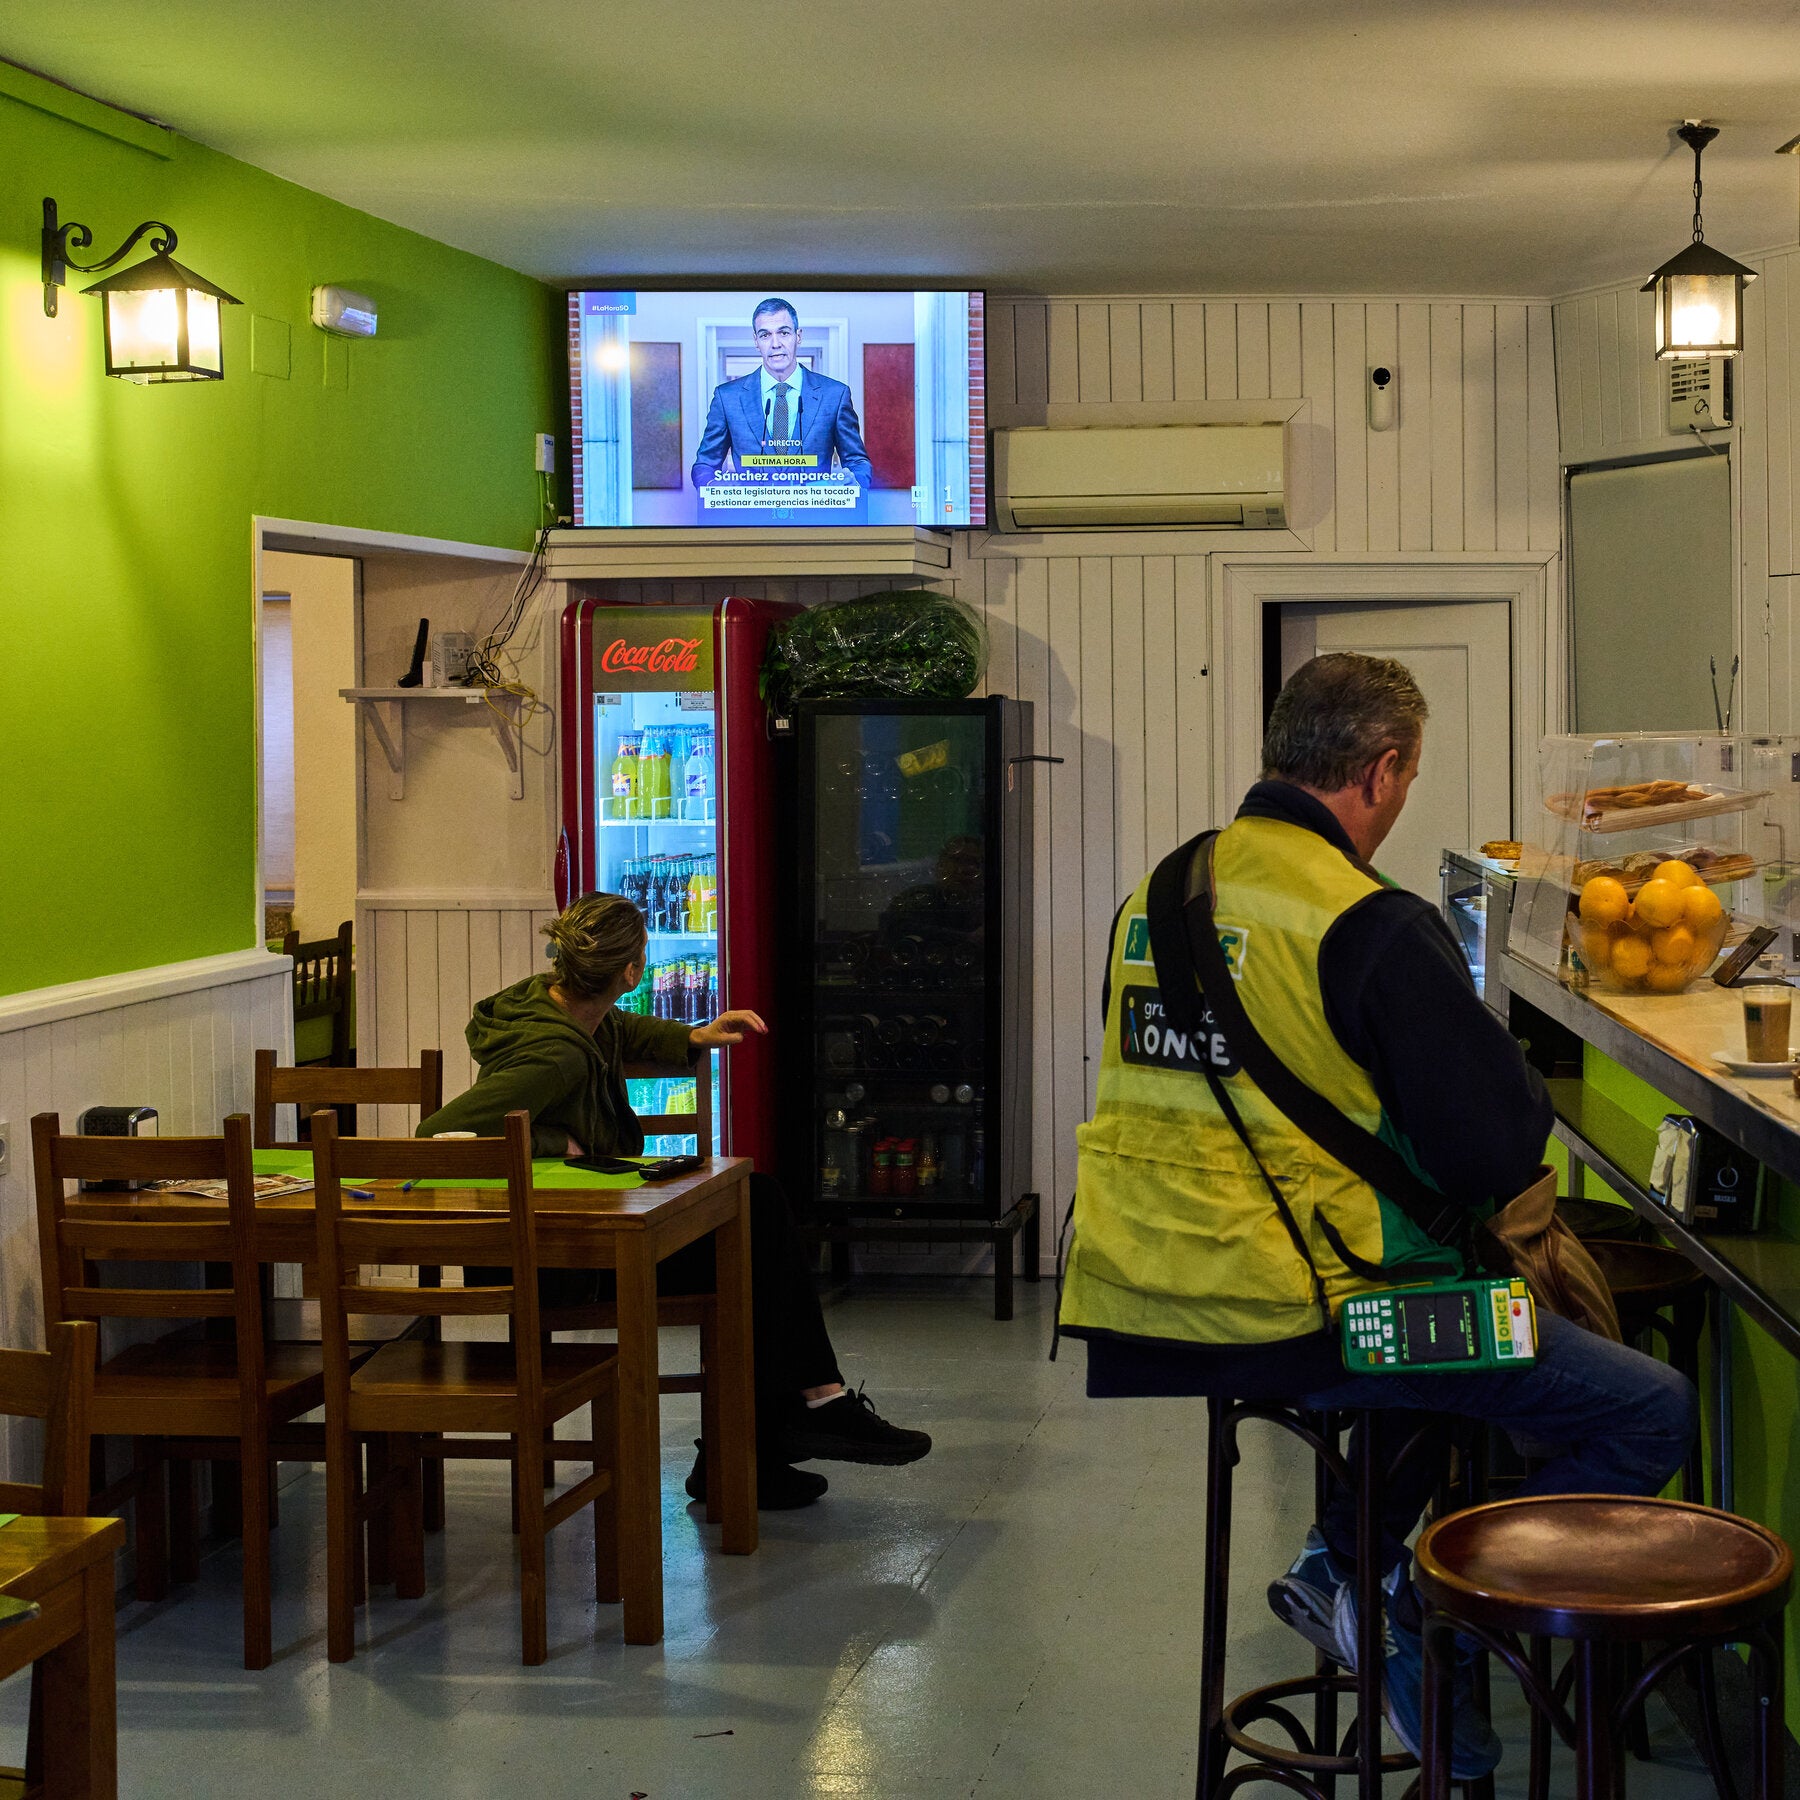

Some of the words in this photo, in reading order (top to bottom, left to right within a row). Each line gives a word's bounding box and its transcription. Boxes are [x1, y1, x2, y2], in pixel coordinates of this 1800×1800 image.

[768, 439, 801, 447] DIRECTO
[752, 456, 782, 465] ÚLTIMA
[783, 457, 807, 465] HORA
[714, 469, 769, 481] Sánchez
[771, 472, 845, 485] comparece
[723, 488, 742, 496] esta
[744, 487, 791, 498] legislatura
[793, 488, 808, 496] nos
[811, 487, 822, 496] ha
[824, 487, 855, 496] tocado
[710, 498, 751, 508] gestionar
[753, 499, 809, 508] emergencias
[811, 498, 851, 507] inéditas"
[601, 638, 704, 672] Coca-Cola
[1495, 1294, 1510, 1338] ONCE
